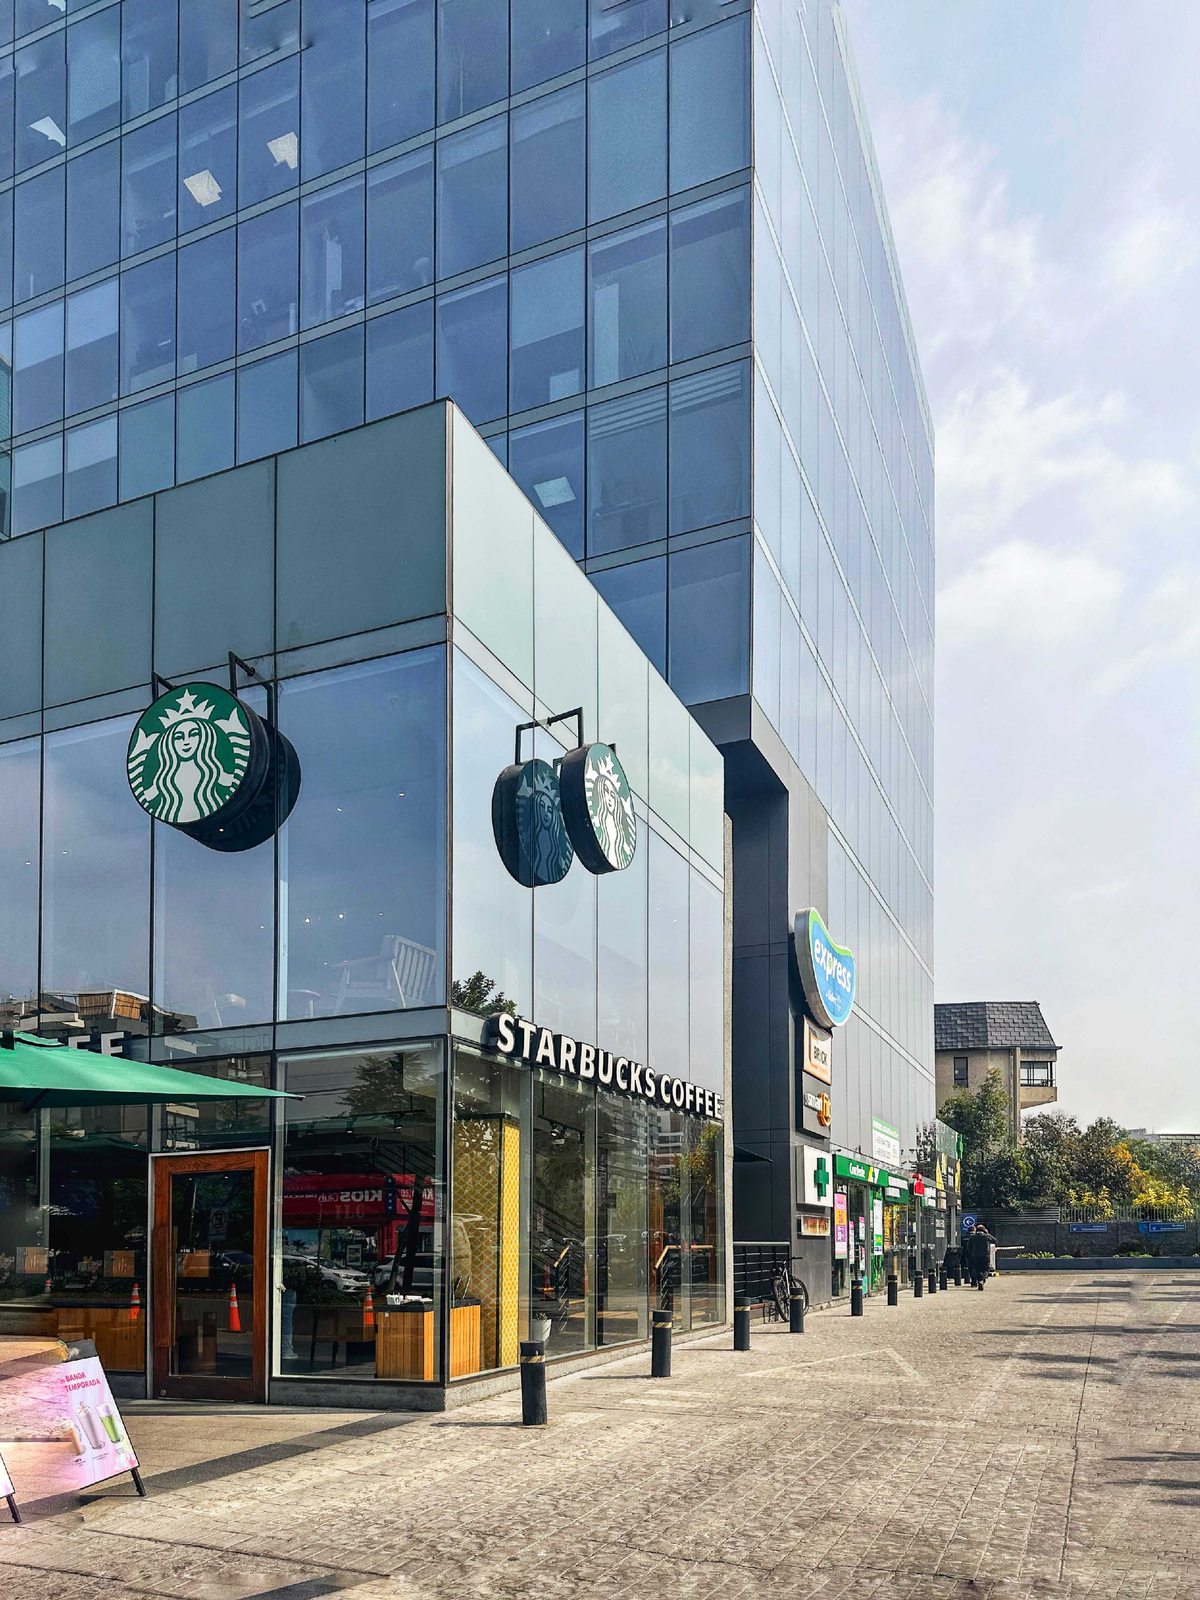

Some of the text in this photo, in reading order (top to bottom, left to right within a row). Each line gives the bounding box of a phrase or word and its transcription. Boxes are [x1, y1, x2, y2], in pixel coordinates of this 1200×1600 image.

[814, 936, 852, 993] express
[496, 1012, 722, 1119] STARBUCKS COFFEE
[64, 1379, 101, 1392] TEMPORADA
